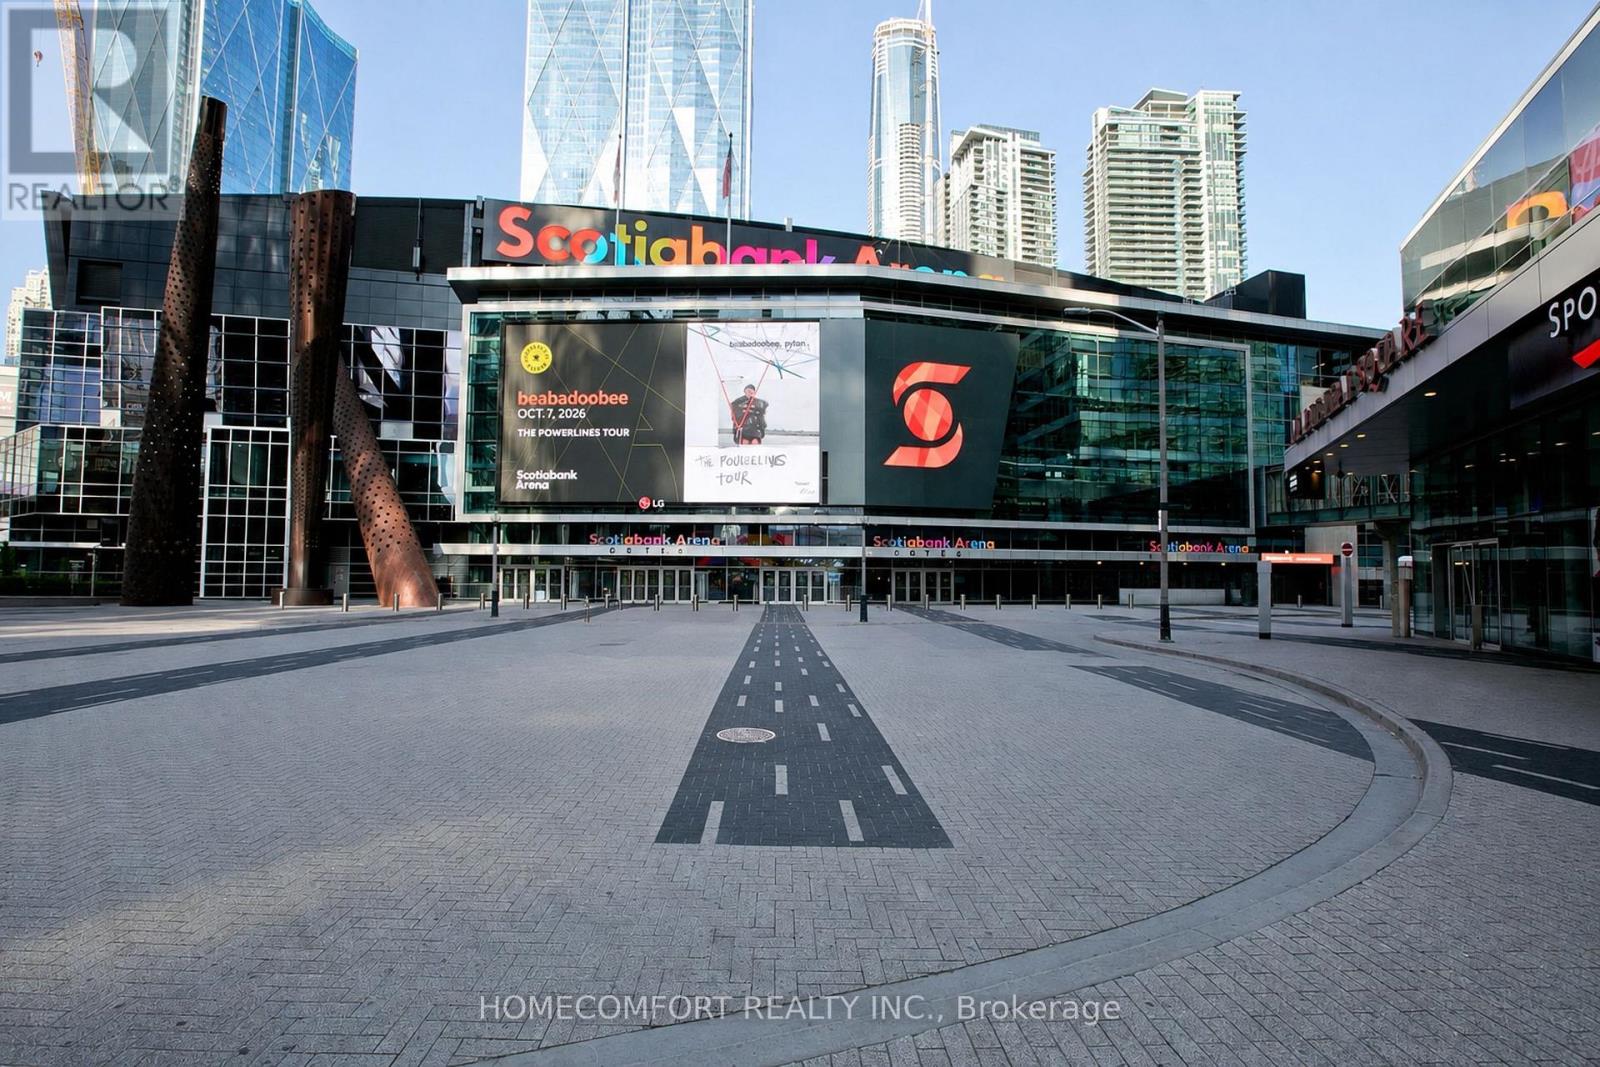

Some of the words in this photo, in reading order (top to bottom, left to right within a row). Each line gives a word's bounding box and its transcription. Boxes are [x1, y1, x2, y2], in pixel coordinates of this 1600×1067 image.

[517, 390, 629, 405] beabadoobee
[558, 408, 586, 419] 2026
[517, 429, 536, 437] THE
[538, 428, 601, 437] POWERLINES
[603, 428, 630, 437] TOUR
[516, 470, 578, 480] Scotiabank
[515, 480, 550, 490] Arena
[652, 500, 665, 508] LG
[589, 534, 670, 545] Scotiabank
[676, 534, 720, 545] Arena
[873, 536, 950, 549] Scotiabank
[955, 538, 995, 549] Arena
[1216, 542, 1249, 553] Arena
